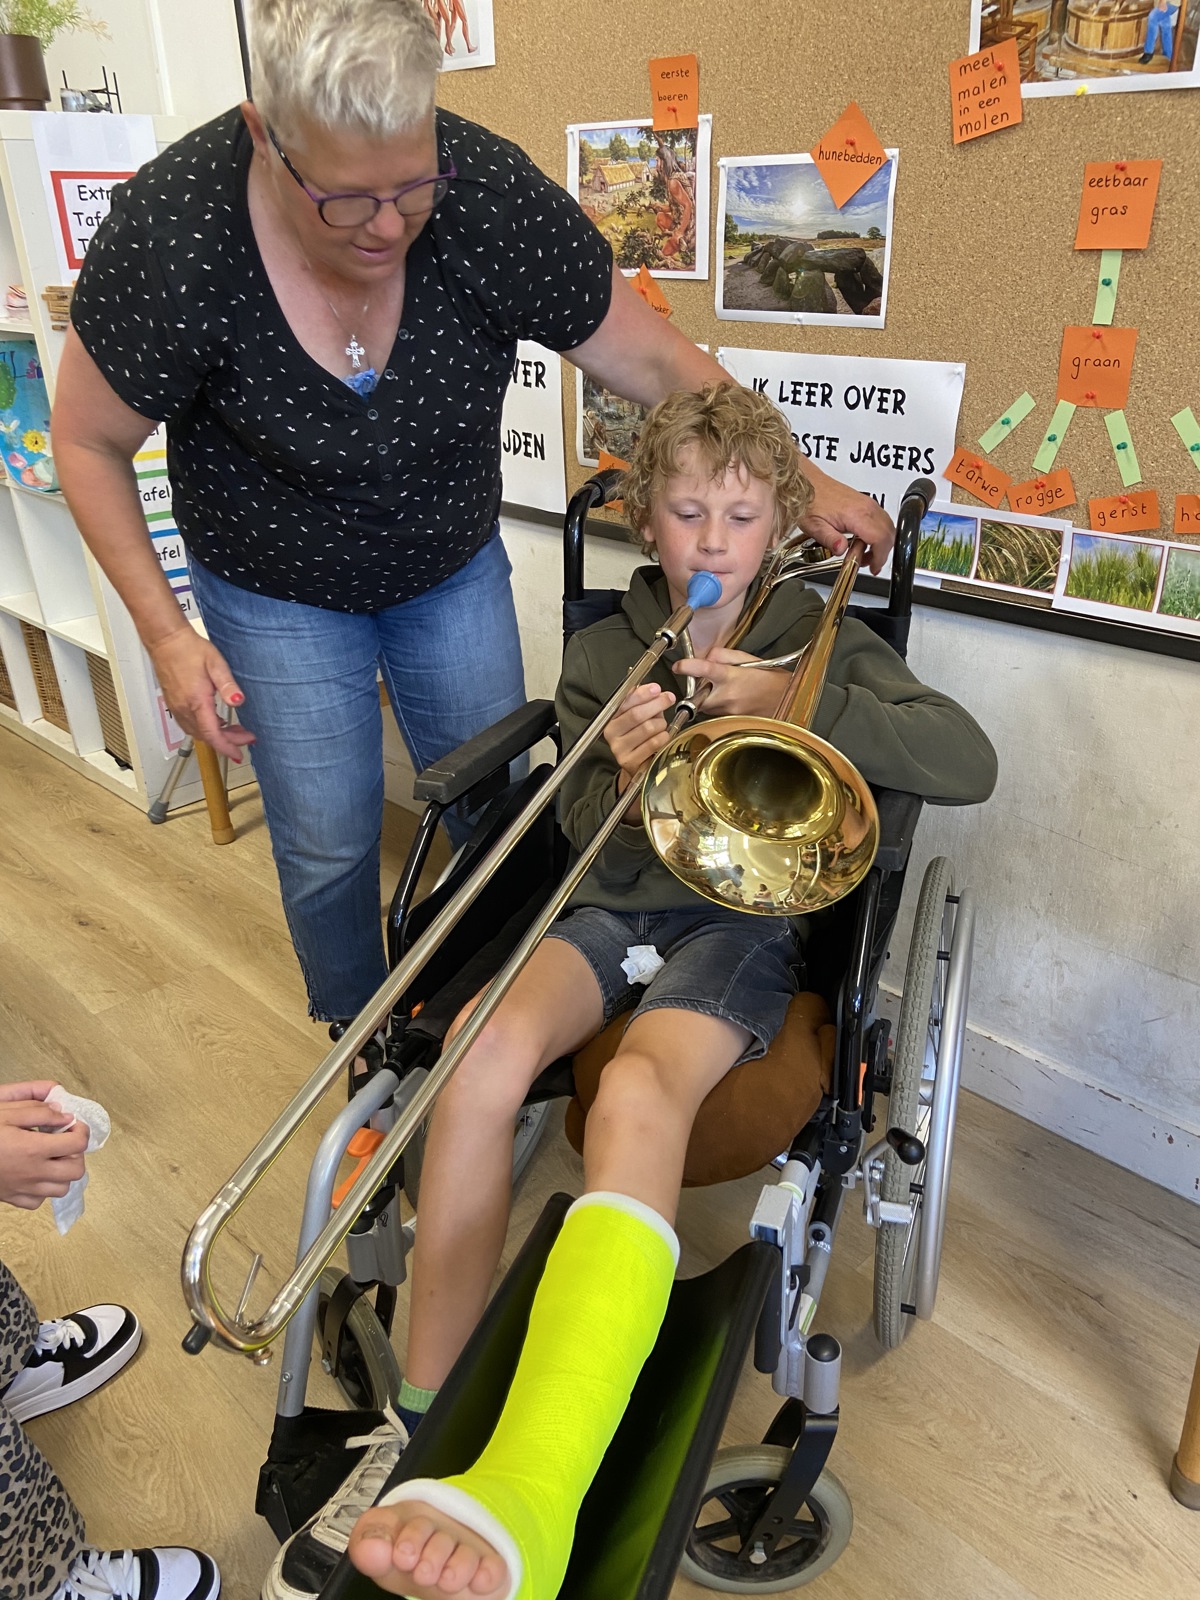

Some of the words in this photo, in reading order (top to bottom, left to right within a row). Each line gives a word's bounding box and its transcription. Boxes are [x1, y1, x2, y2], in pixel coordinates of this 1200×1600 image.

[660, 68, 690, 79] eerste
[959, 52, 995, 77] meel
[657, 91, 689, 102] boeren
[958, 75, 1007, 101] malen
[959, 104, 970, 117] in
[978, 96, 1001, 109] een
[959, 110, 1010, 137] molen
[818, 144, 882, 165] hunebedden
[77, 185, 112, 201] Extr
[1088, 174, 1149, 188] eetbaar
[72, 211, 101, 227] Taf
[1091, 204, 1129, 225] gras
[1071, 356, 1121, 380] graan
[778, 380, 833, 408] LEER
[843, 385, 907, 416] OVER
[503, 429, 546, 461] JDEN
[850, 441, 935, 475] JAGERS
[955, 458, 999, 497] tarwe
[139, 485, 170, 501] afel
[1015, 485, 1065, 509] rogge
[1097, 503, 1148, 527] gerst
